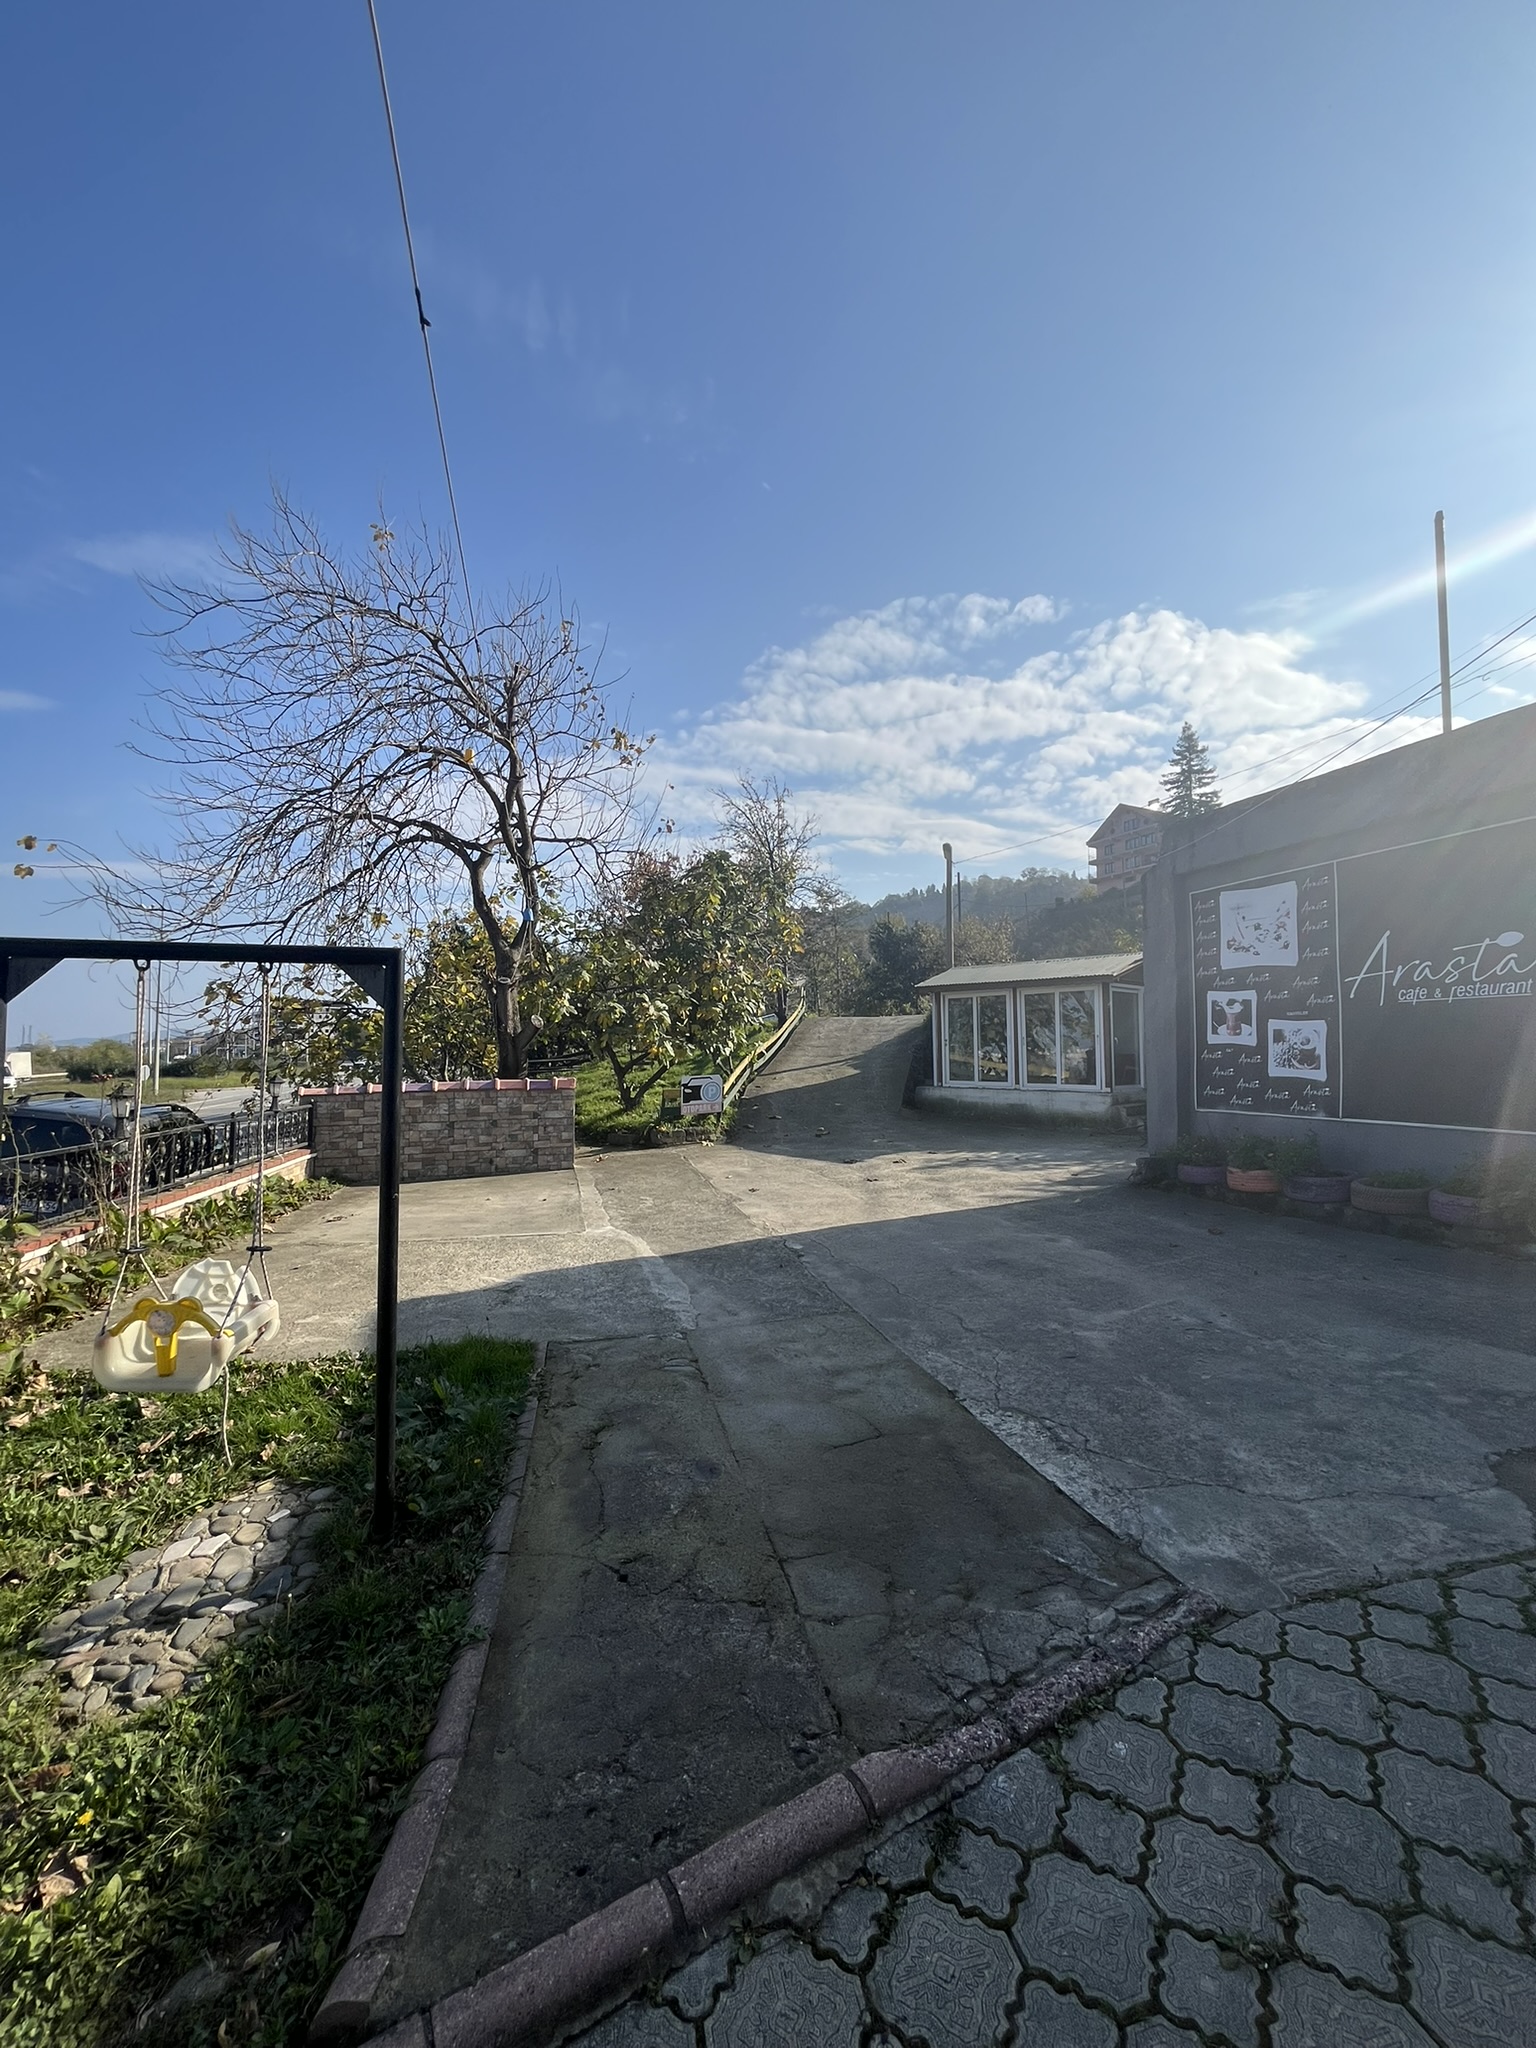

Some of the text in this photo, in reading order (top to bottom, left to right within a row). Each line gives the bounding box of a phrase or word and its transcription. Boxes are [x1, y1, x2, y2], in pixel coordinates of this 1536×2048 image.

[1345, 930, 1536, 1006] Arasta
[1398, 978, 1533, 1005] cafe & restaurant
[708, 1084, 717, 1097] P
